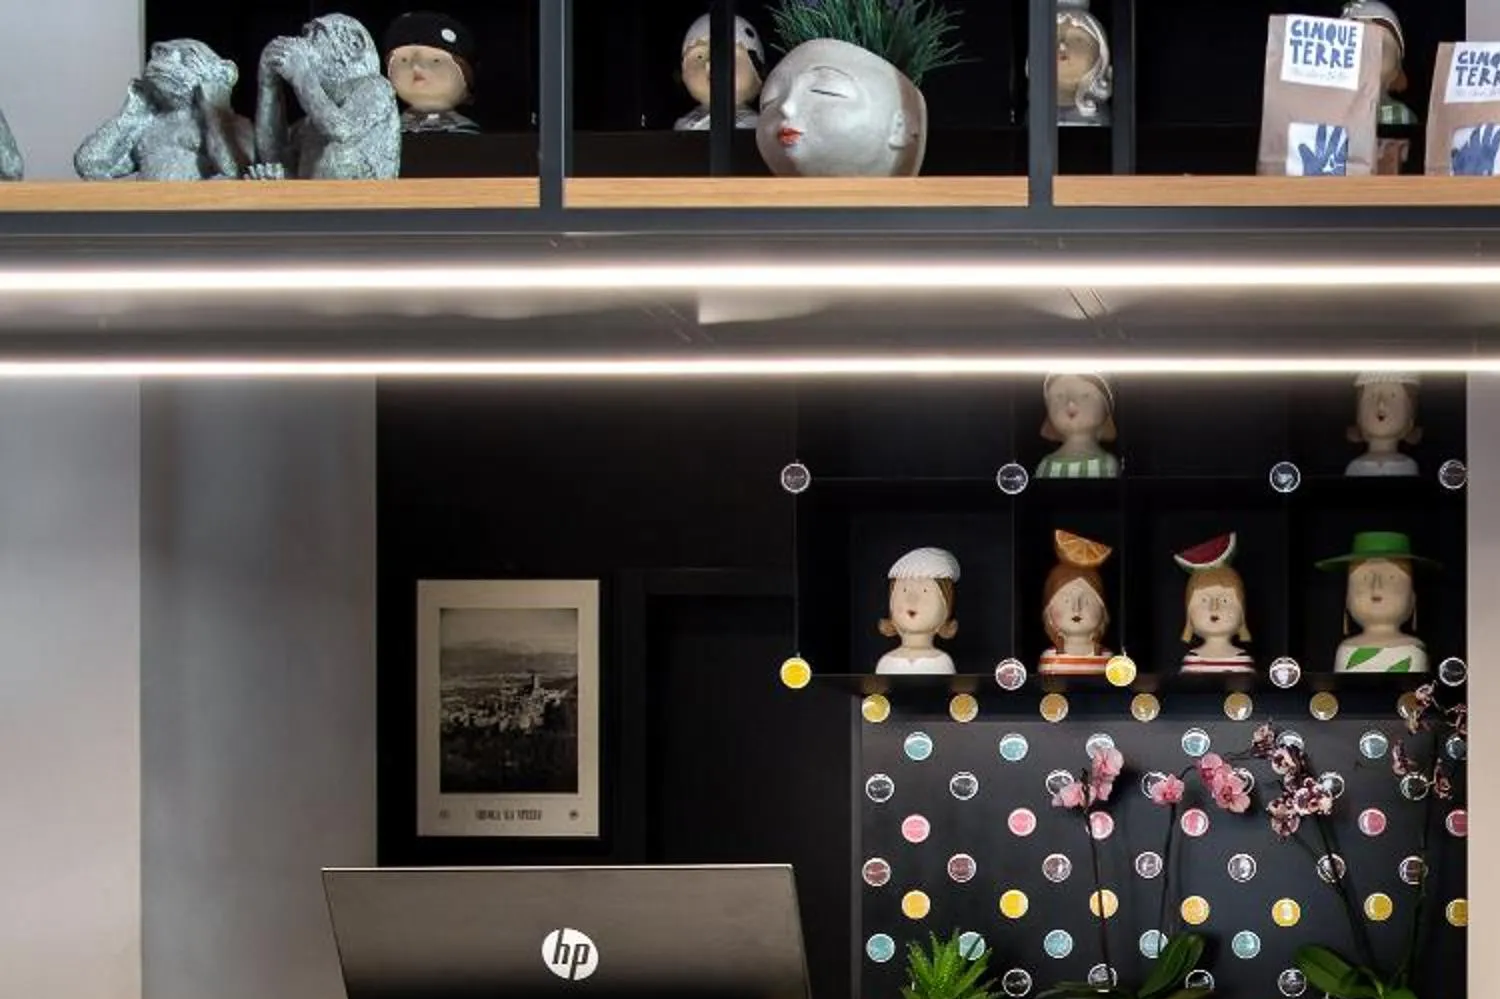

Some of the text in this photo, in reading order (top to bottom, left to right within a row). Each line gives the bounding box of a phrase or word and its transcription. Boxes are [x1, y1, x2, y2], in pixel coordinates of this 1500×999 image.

[1291, 19, 1357, 47] CINQUE
[1290, 38, 1355, 69] TERRE
[552, 928, 590, 980] hp
